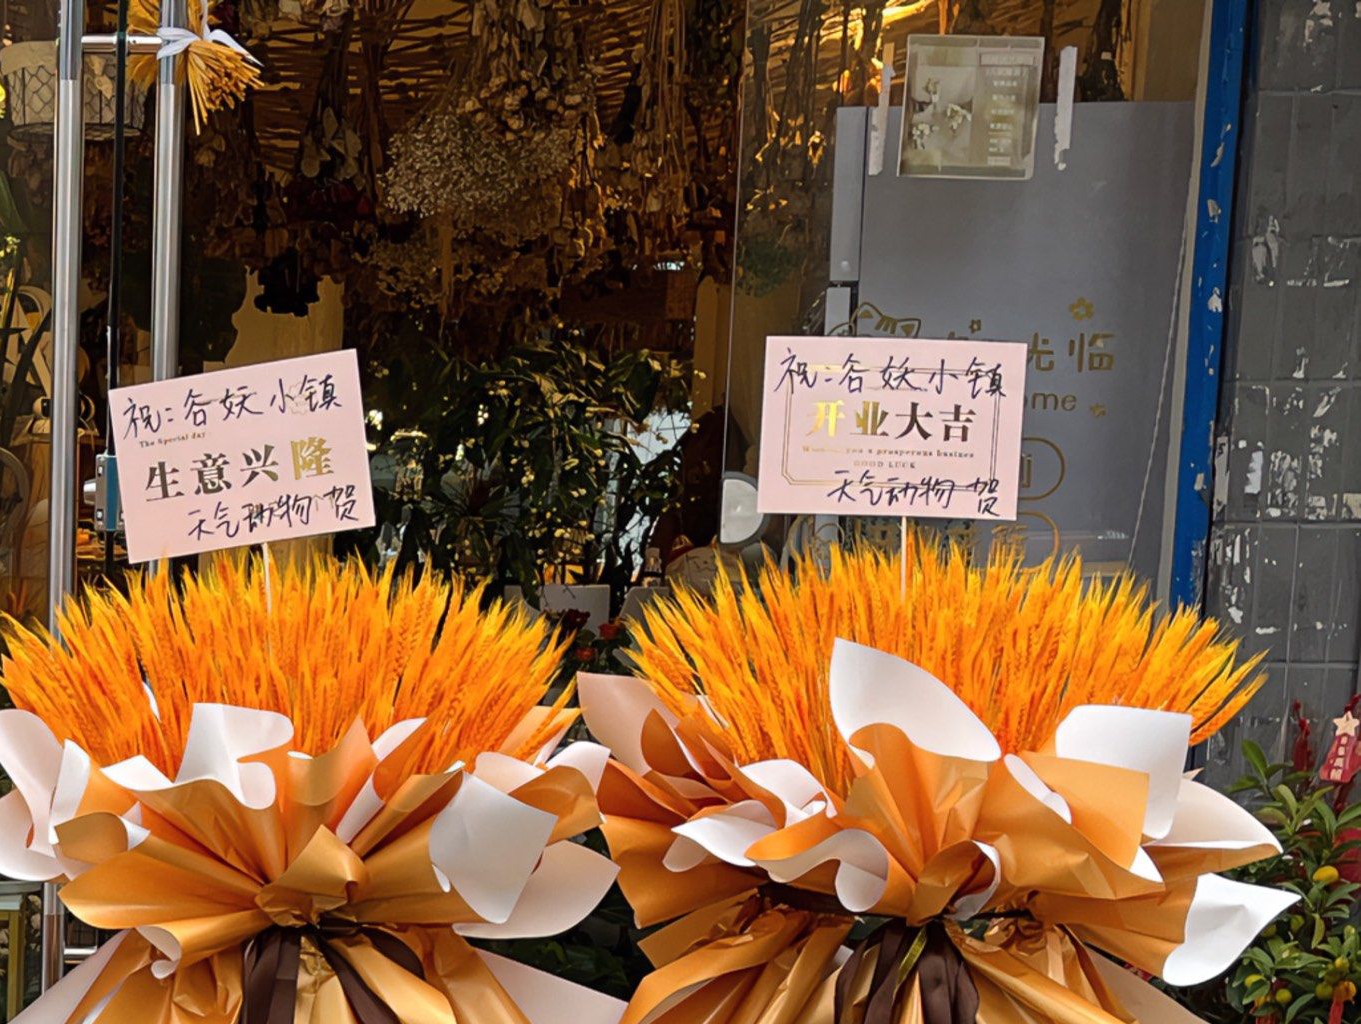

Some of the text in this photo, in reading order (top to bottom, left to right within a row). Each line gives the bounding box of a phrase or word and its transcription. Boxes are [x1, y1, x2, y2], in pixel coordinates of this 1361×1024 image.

[804, 400, 976, 442] 开业大吉
[144, 437, 334, 502] 生意兴隆
